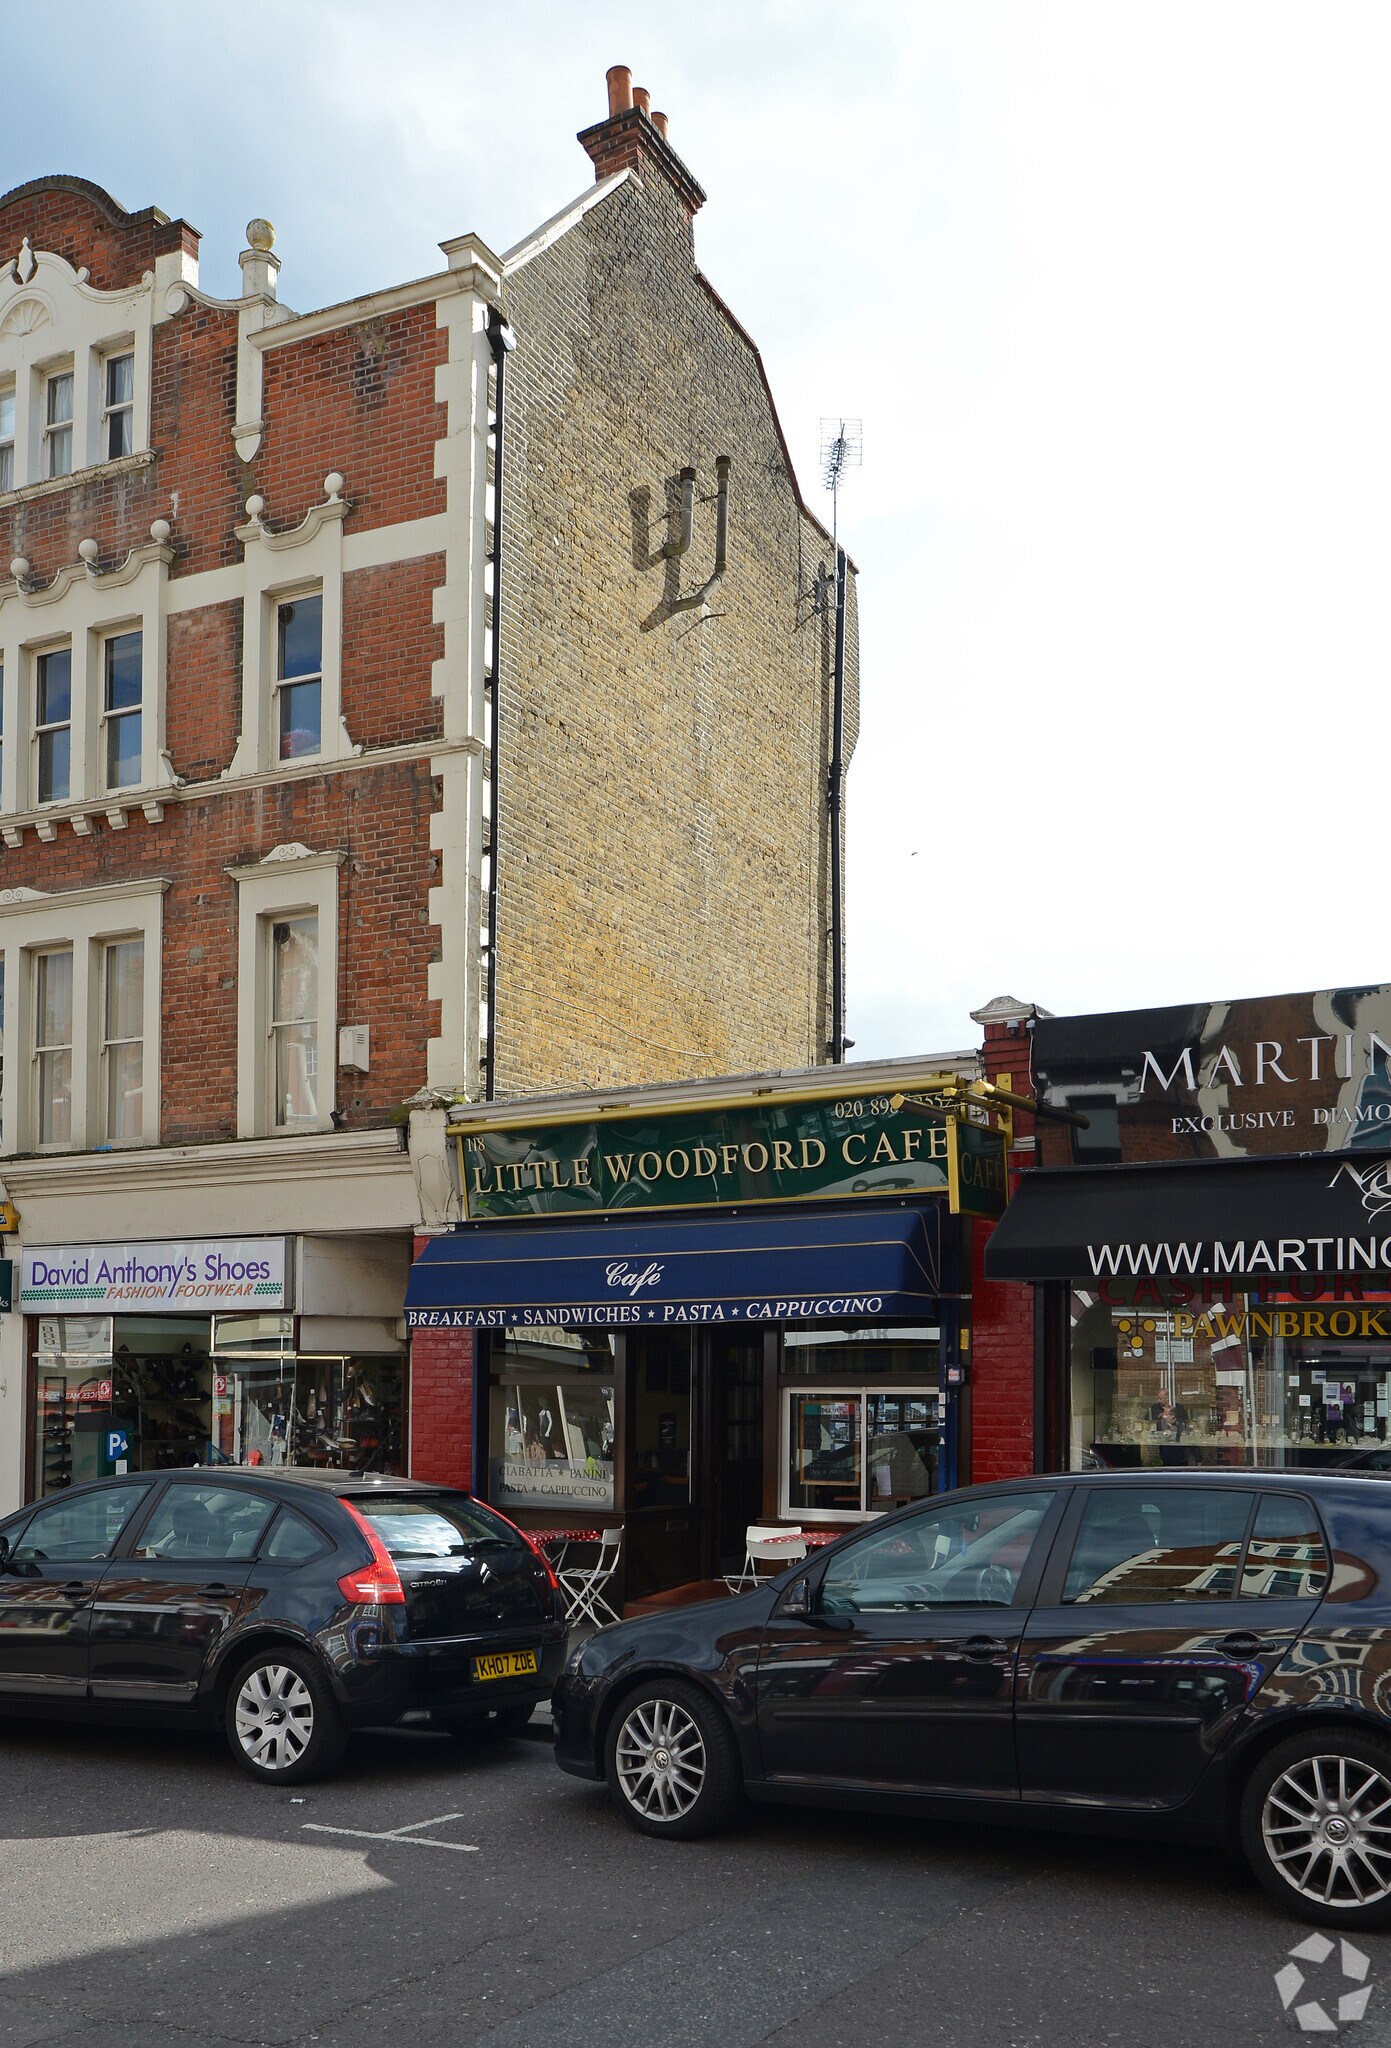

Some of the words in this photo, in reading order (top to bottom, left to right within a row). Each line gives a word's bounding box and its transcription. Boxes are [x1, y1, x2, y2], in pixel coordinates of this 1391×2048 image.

[835, 1101, 864, 1119] 020
[1171, 1109, 1295, 1134] EXCLUSIVE
[466, 1136, 486, 1152] 118
[472, 1158, 592, 1194] LITTLE
[603, 1138, 826, 1183] WOODFORD
[31, 1258, 89, 1286] David
[95, 1256, 196, 1298] Anthony's
[204, 1253, 271, 1281] Shoes
[605, 1262, 665, 1297] Café
[106, 1285, 168, 1299] FASHION
[175, 1282, 254, 1298] FOOTWEAR
[1097, 1274, 1235, 1305] CASH
[408, 1309, 507, 1326] BREAKFAST
[523, 1305, 641, 1325] SANDWICHES
[663, 1304, 725, 1322] PASTA
[745, 1296, 883, 1319] CAPPUCCINO
[498, 1466, 553, 1478] CIABATTA
[569, 1468, 607, 1480] PANINI
[499, 1483, 528, 1493] PASTA
[540, 1484, 607, 1497] CAPPUCCINO
[478, 1656, 510, 1677] KH07
[512, 1652, 534, 1672] ZDE
